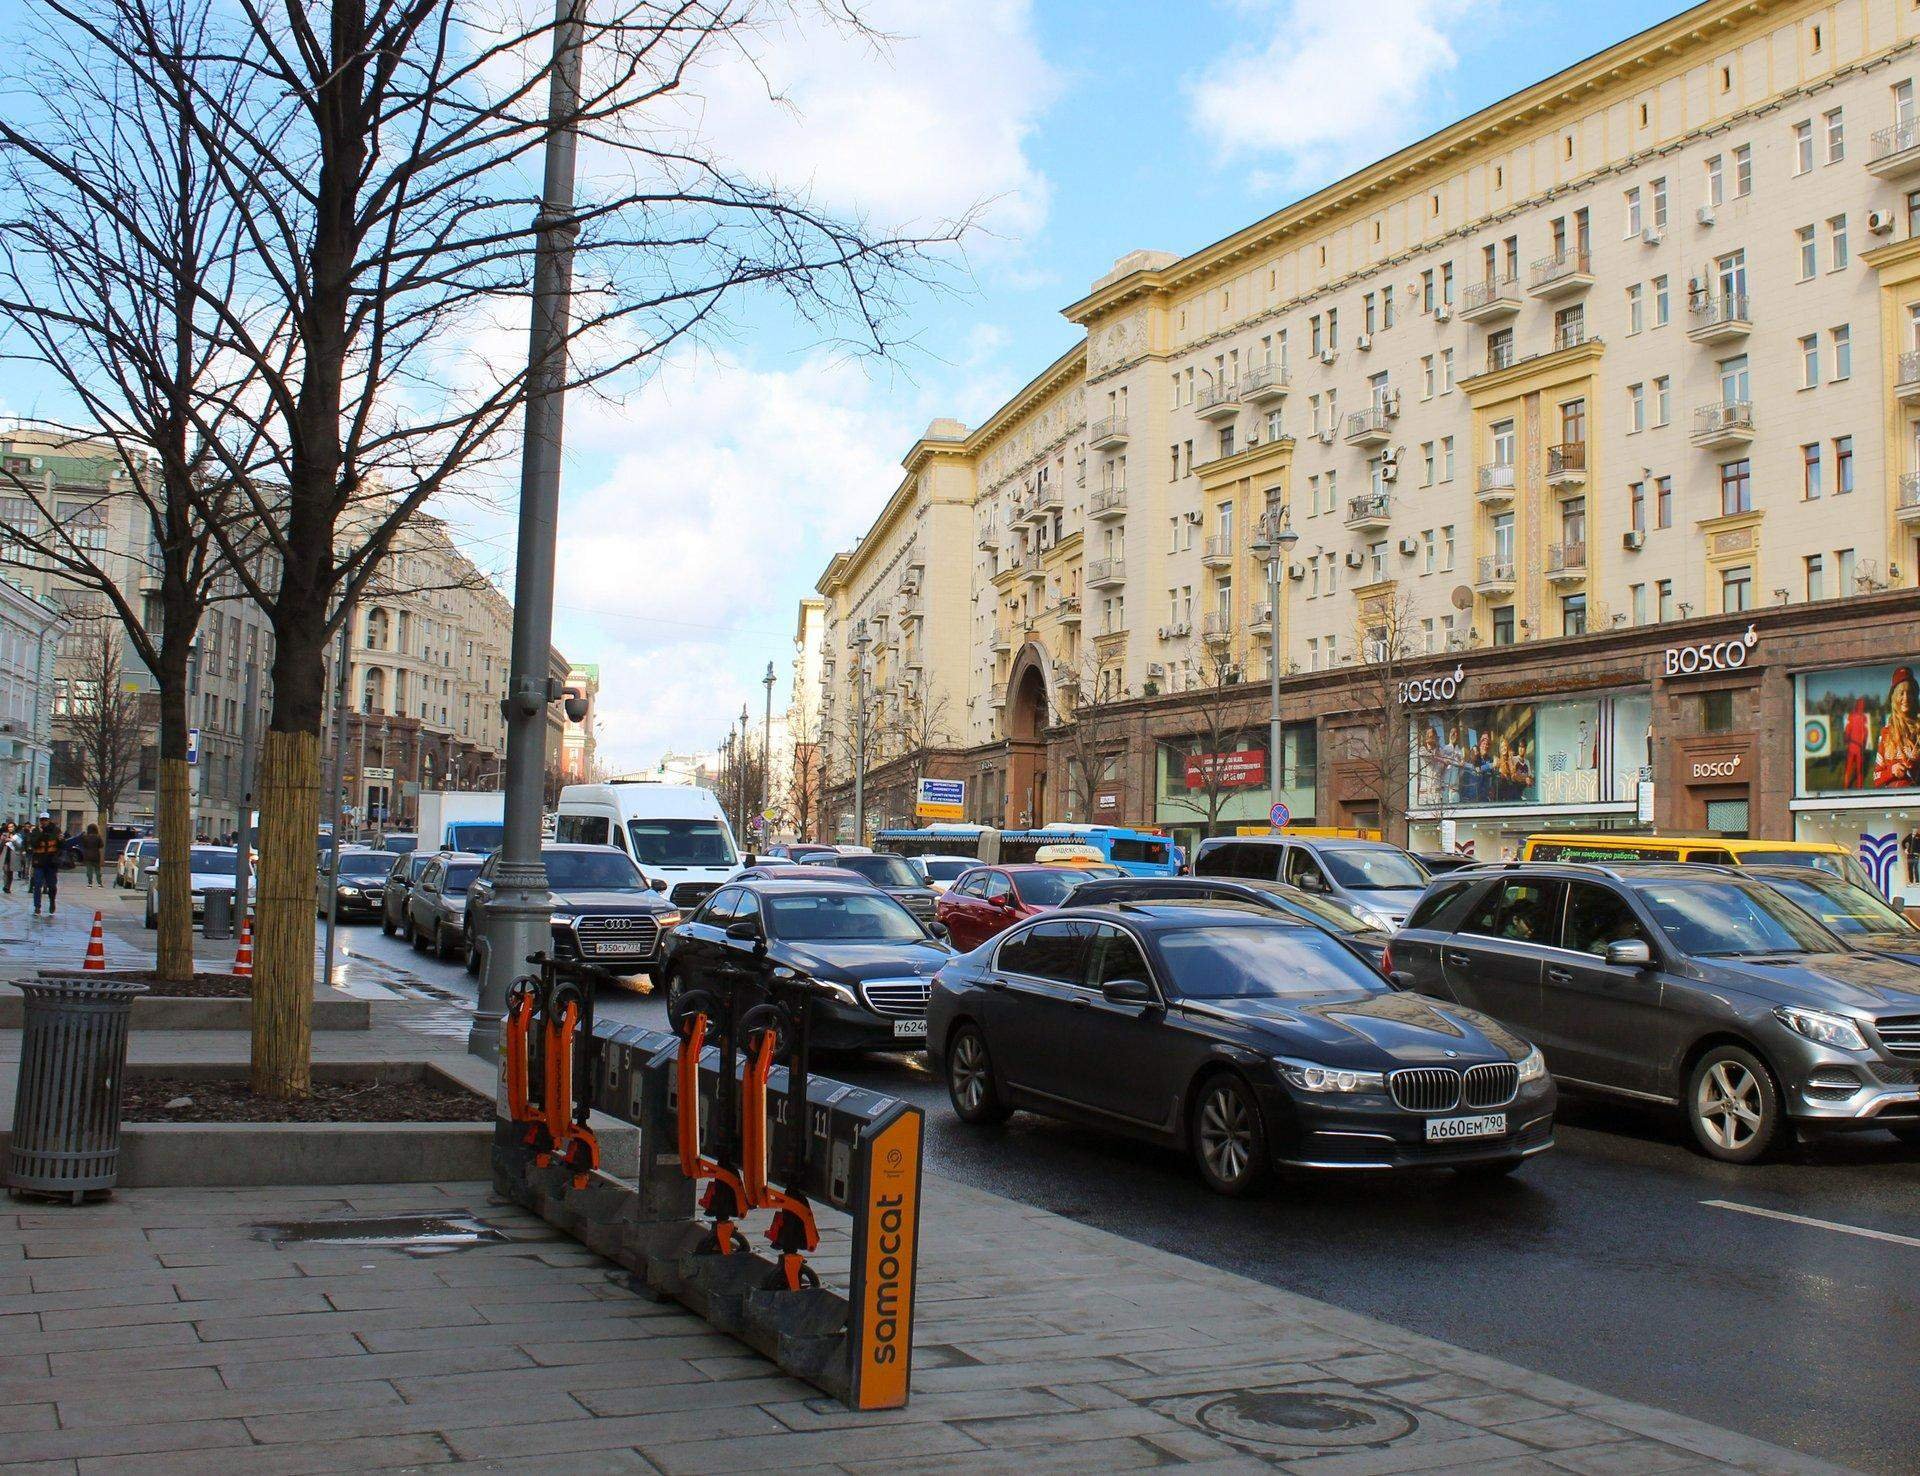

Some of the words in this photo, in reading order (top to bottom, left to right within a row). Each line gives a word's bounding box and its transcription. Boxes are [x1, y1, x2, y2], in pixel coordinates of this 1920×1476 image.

[1665, 640, 1746, 675] BOSCO
[1398, 677, 1456, 704] BOSCO
[1693, 761, 1735, 778] BOSCO
[813, 1110, 828, 1138] 11
[1484, 1115, 1503, 1129] 790
[874, 1193, 904, 1365] samocat
